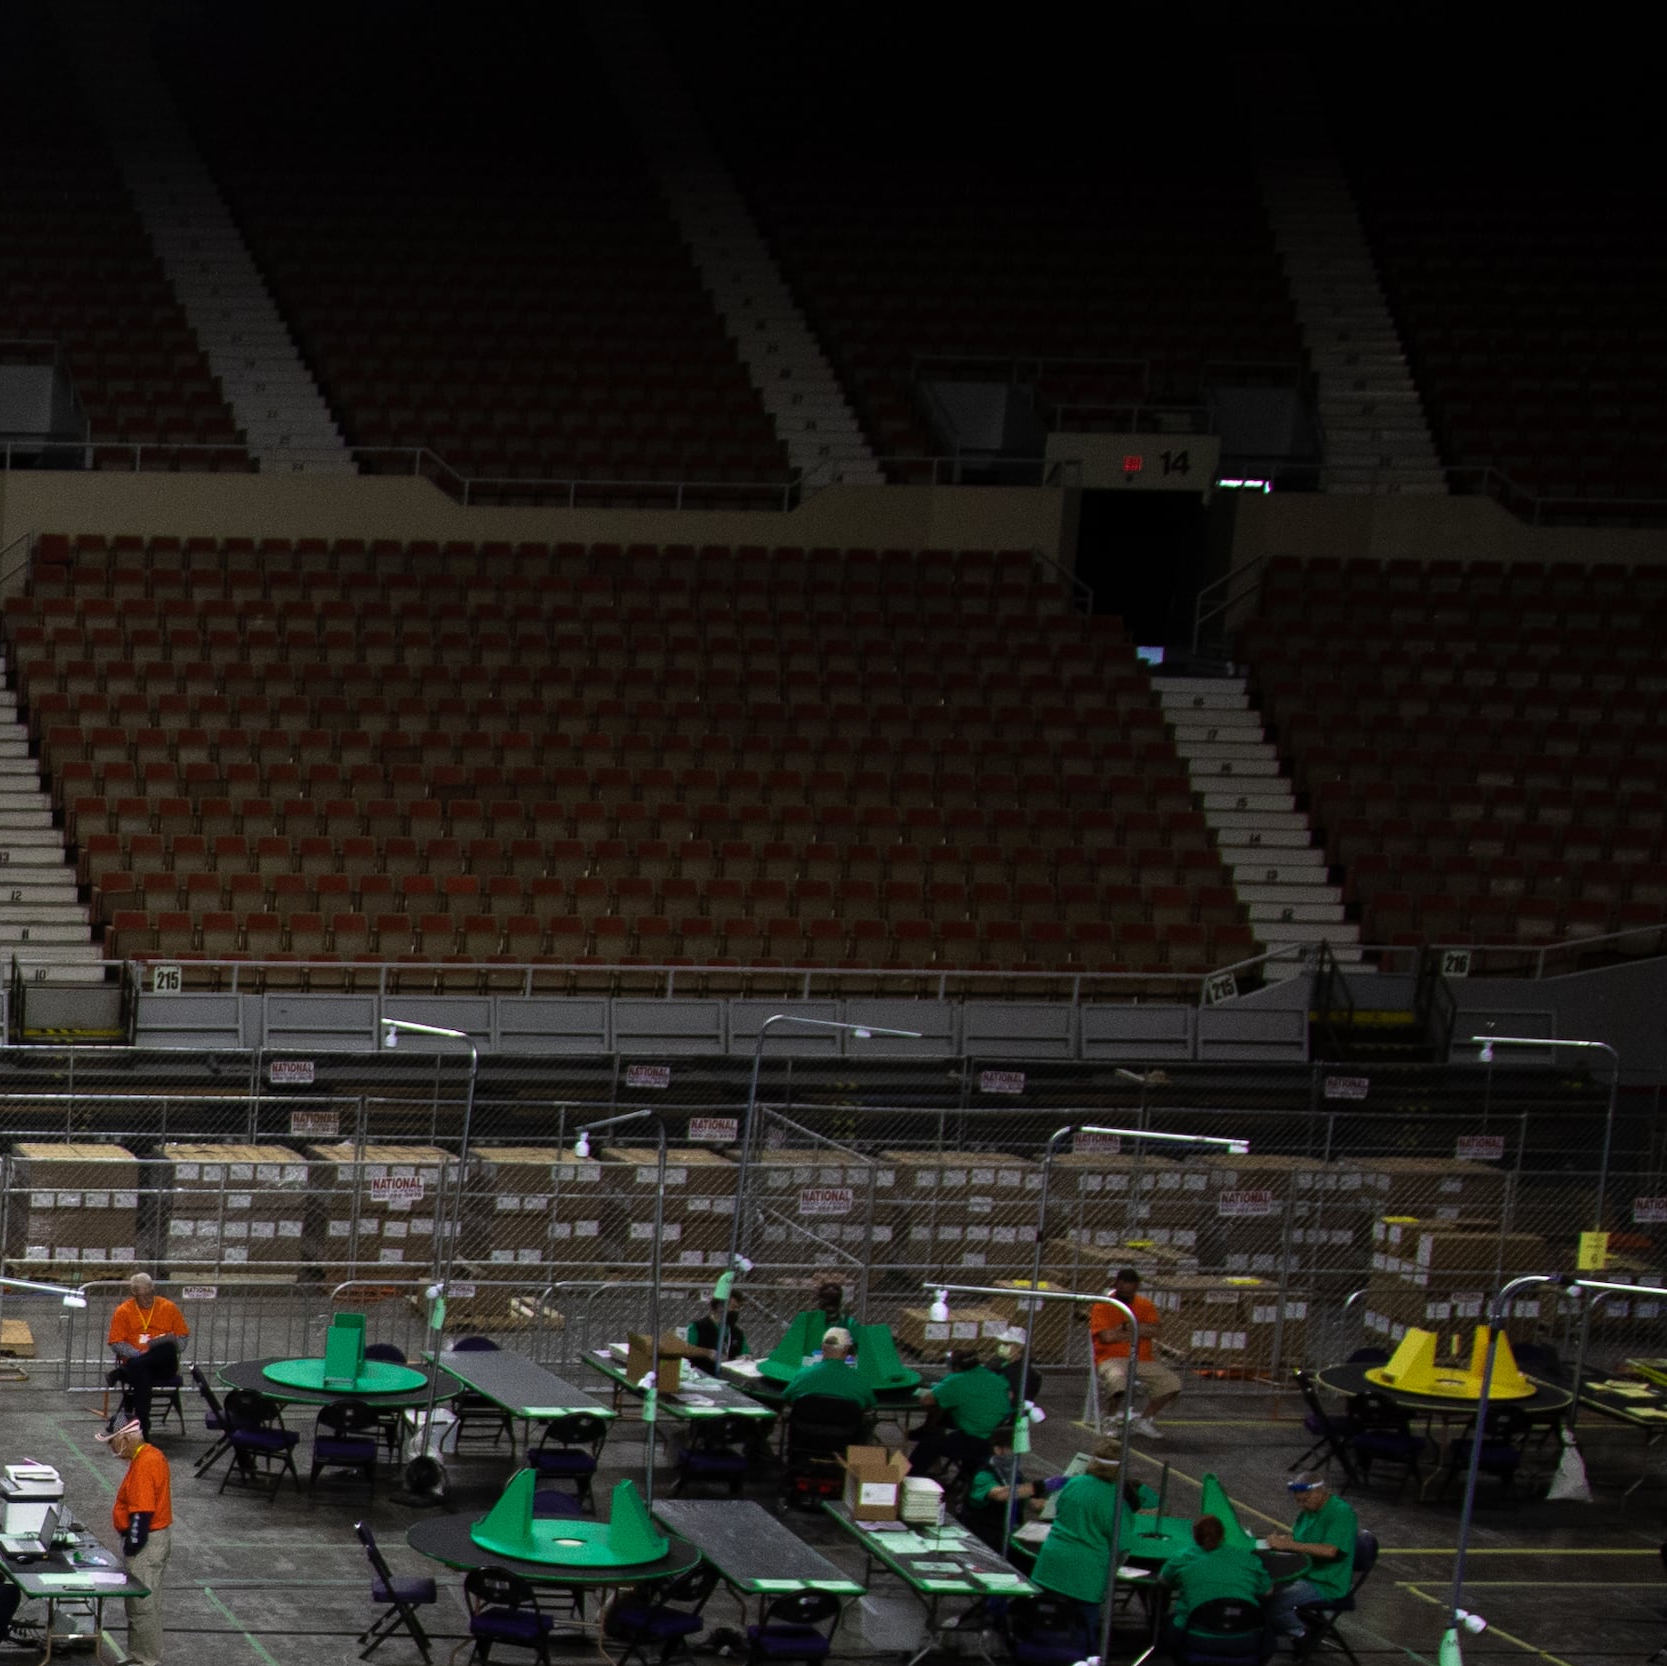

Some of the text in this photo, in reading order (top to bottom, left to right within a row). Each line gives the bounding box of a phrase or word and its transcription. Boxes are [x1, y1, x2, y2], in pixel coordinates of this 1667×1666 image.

[1160, 450, 1191, 475] 14
[157, 972, 180, 990] 215
[1211, 979, 1235, 1001] 215
[691, 1119, 735, 1130] NATIONAL
[373, 1178, 423, 1190] NATIONAL
[803, 1191, 851, 1202] NATIONAL
